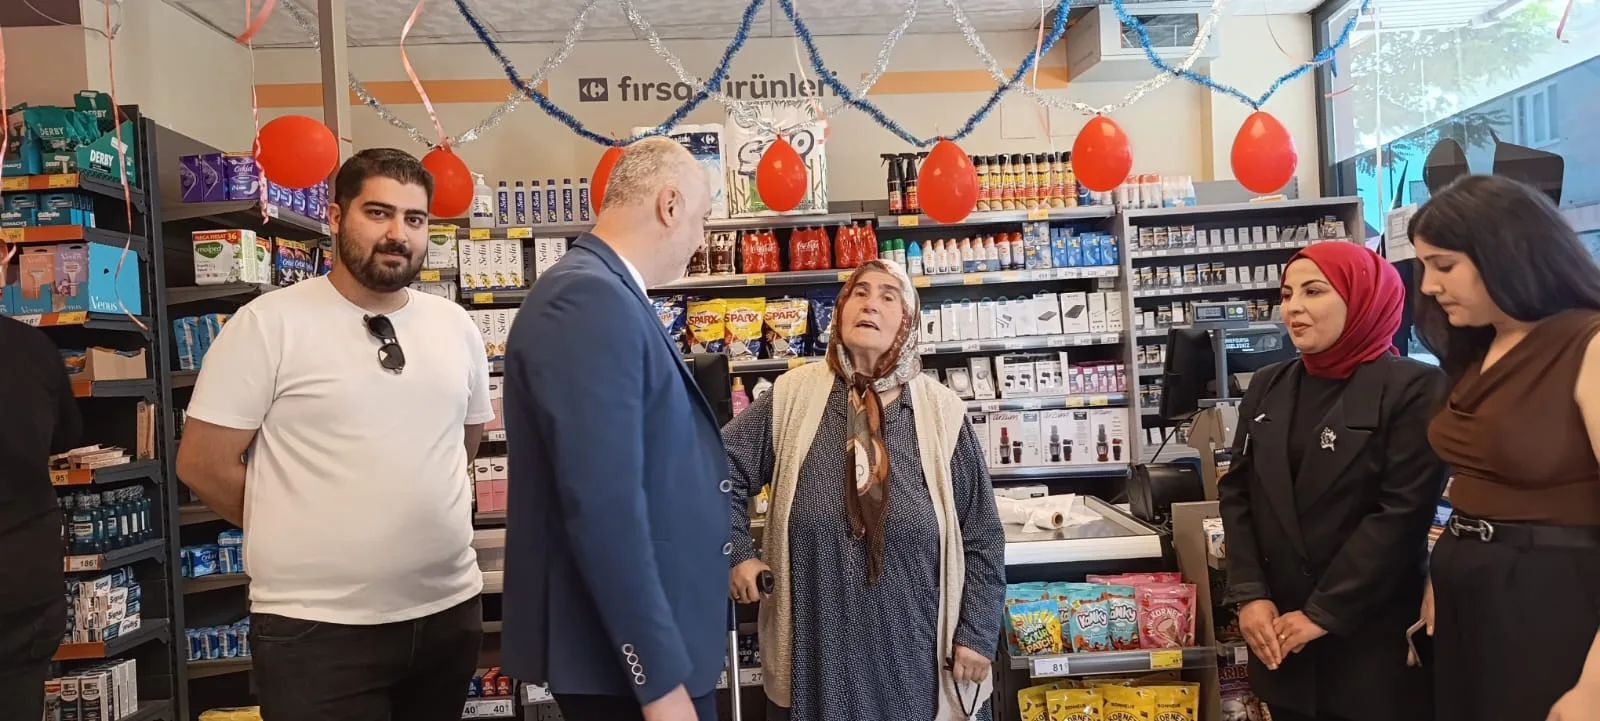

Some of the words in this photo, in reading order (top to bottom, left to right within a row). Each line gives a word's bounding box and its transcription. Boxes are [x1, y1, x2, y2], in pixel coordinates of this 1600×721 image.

[618, 76, 704, 101] fırsa
[90, 149, 114, 167] DERBY
[228, 232, 237, 240] 36
[464, 244, 472, 266] Selin
[479, 244, 487, 266] Selin
[494, 243, 502, 264] Selin
[509, 243, 517, 264] Selin
[91, 295, 118, 311] Venus
[498, 313, 506, 334] Selin
[688, 315, 719, 325] SPARX
[724, 313, 758, 323] SPARX
[765, 311, 800, 320] SPARX
[1024, 628, 1049, 645] SOUR
[1026, 637, 1054, 653] PATCH
[1053, 664, 1063, 672] 81
